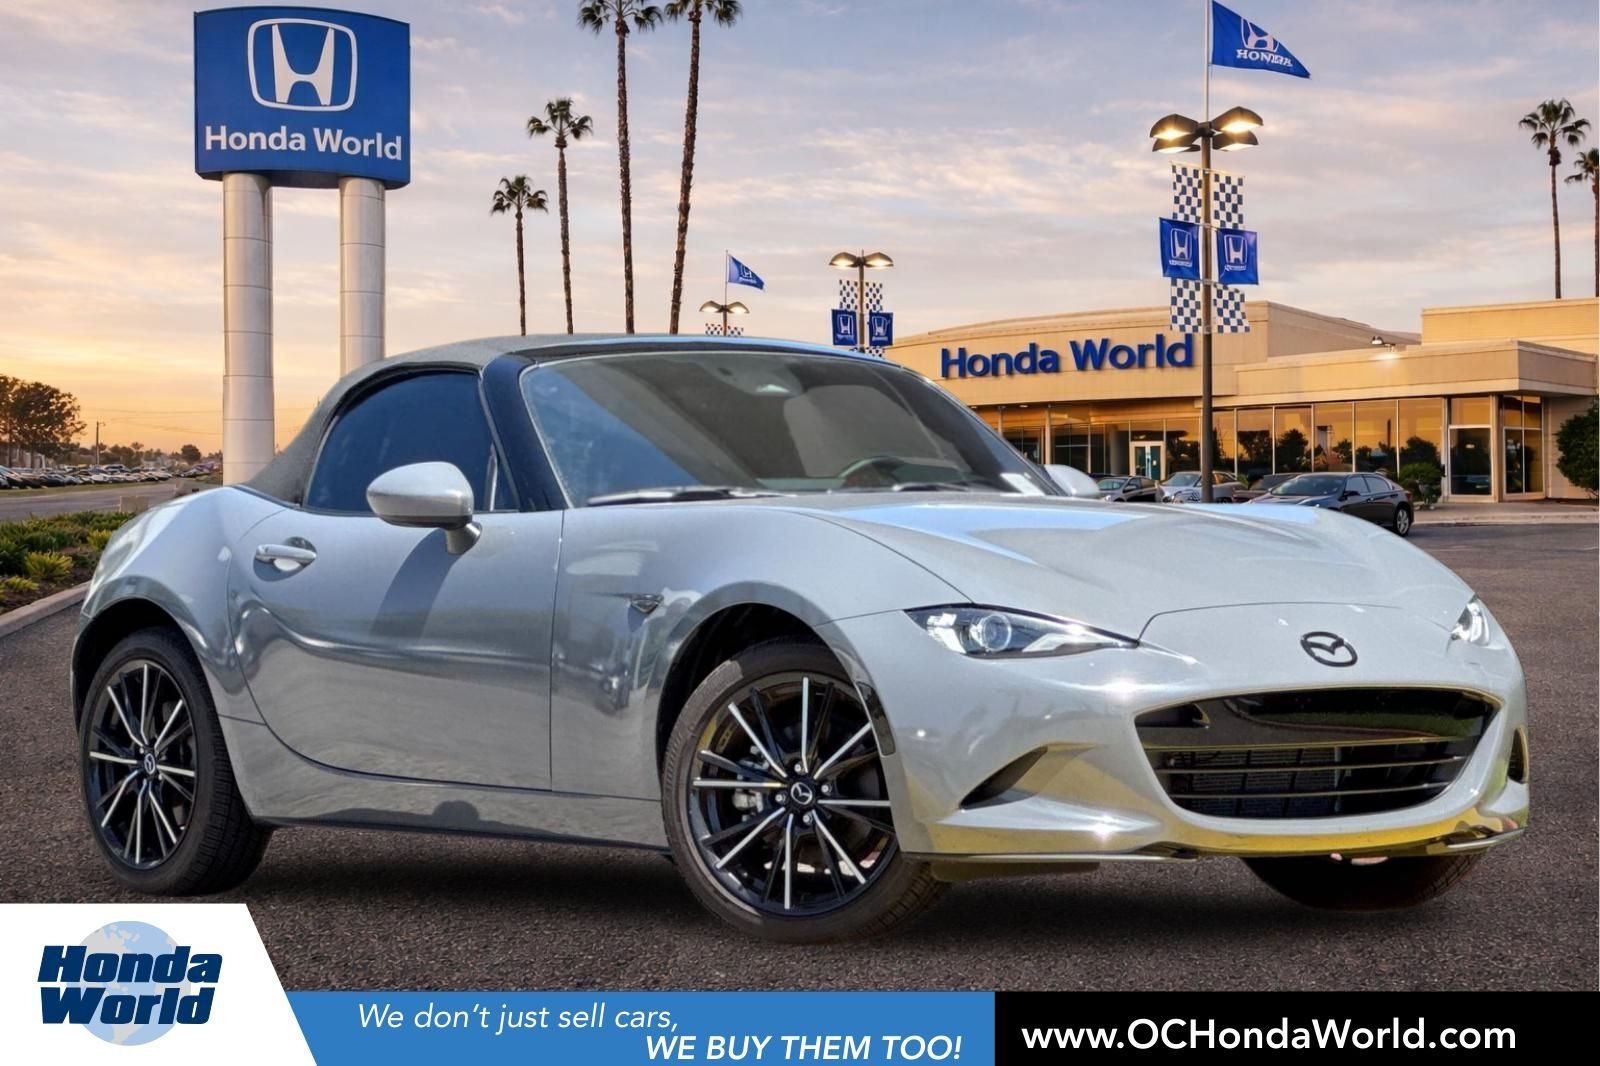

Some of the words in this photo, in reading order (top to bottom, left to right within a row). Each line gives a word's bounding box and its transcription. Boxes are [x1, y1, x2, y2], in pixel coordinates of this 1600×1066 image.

[205, 125, 306, 152] Honda
[313, 127, 402, 161] World
[941, 342, 1061, 378] Honda
[1070, 333, 1194, 371] World
